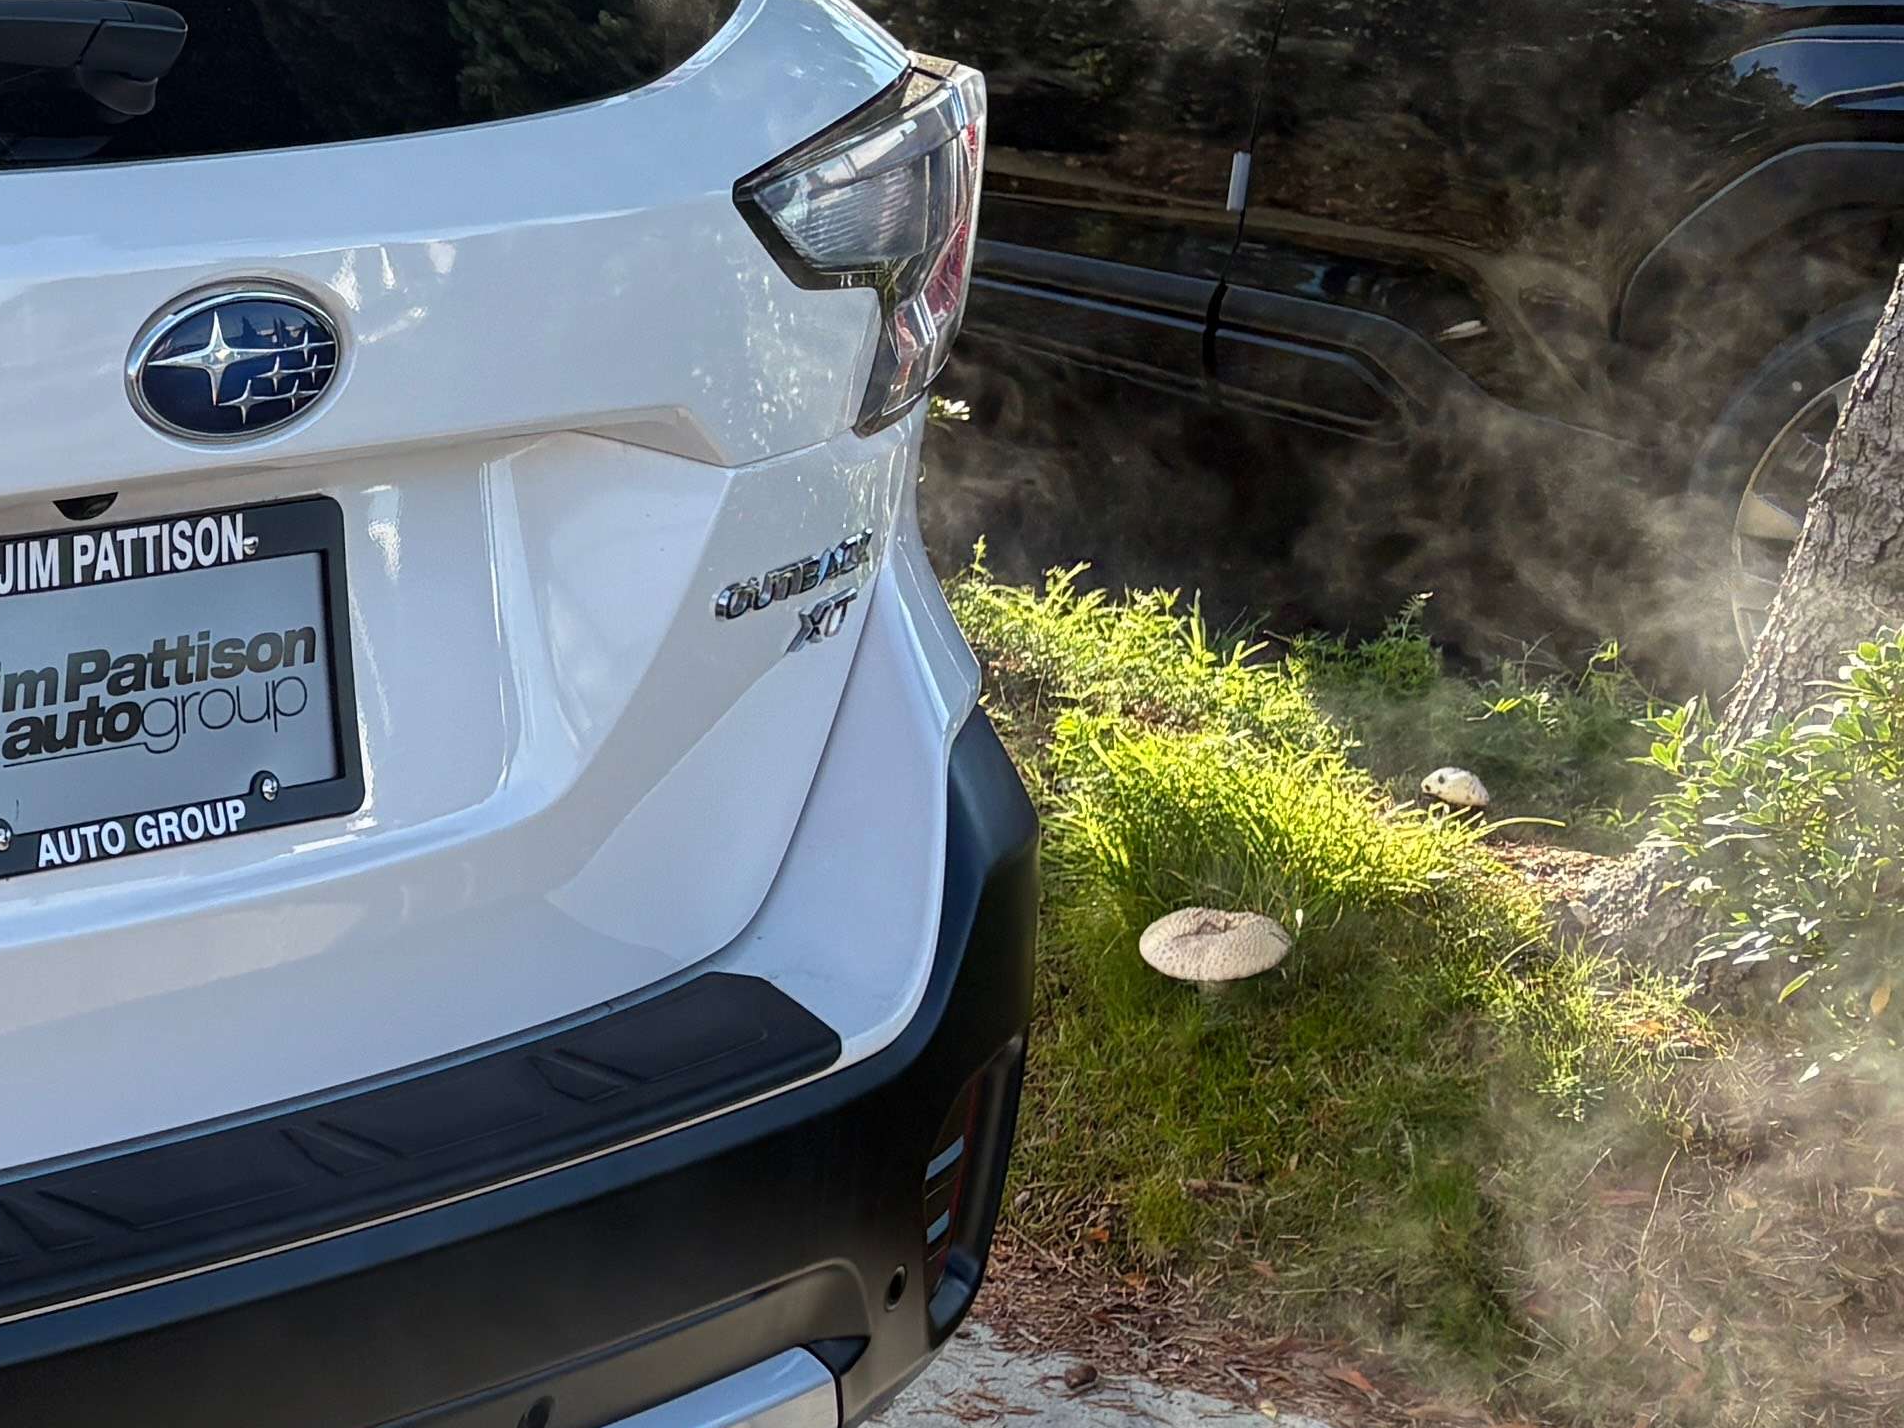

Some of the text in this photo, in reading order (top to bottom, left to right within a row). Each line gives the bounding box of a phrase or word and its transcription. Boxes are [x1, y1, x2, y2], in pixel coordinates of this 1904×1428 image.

[72, 513, 243, 584] PATTISON
[784, 586, 858, 655] XT
[63, 625, 317, 703] Pattison
[37, 798, 247, 869] AUTO GROUP
